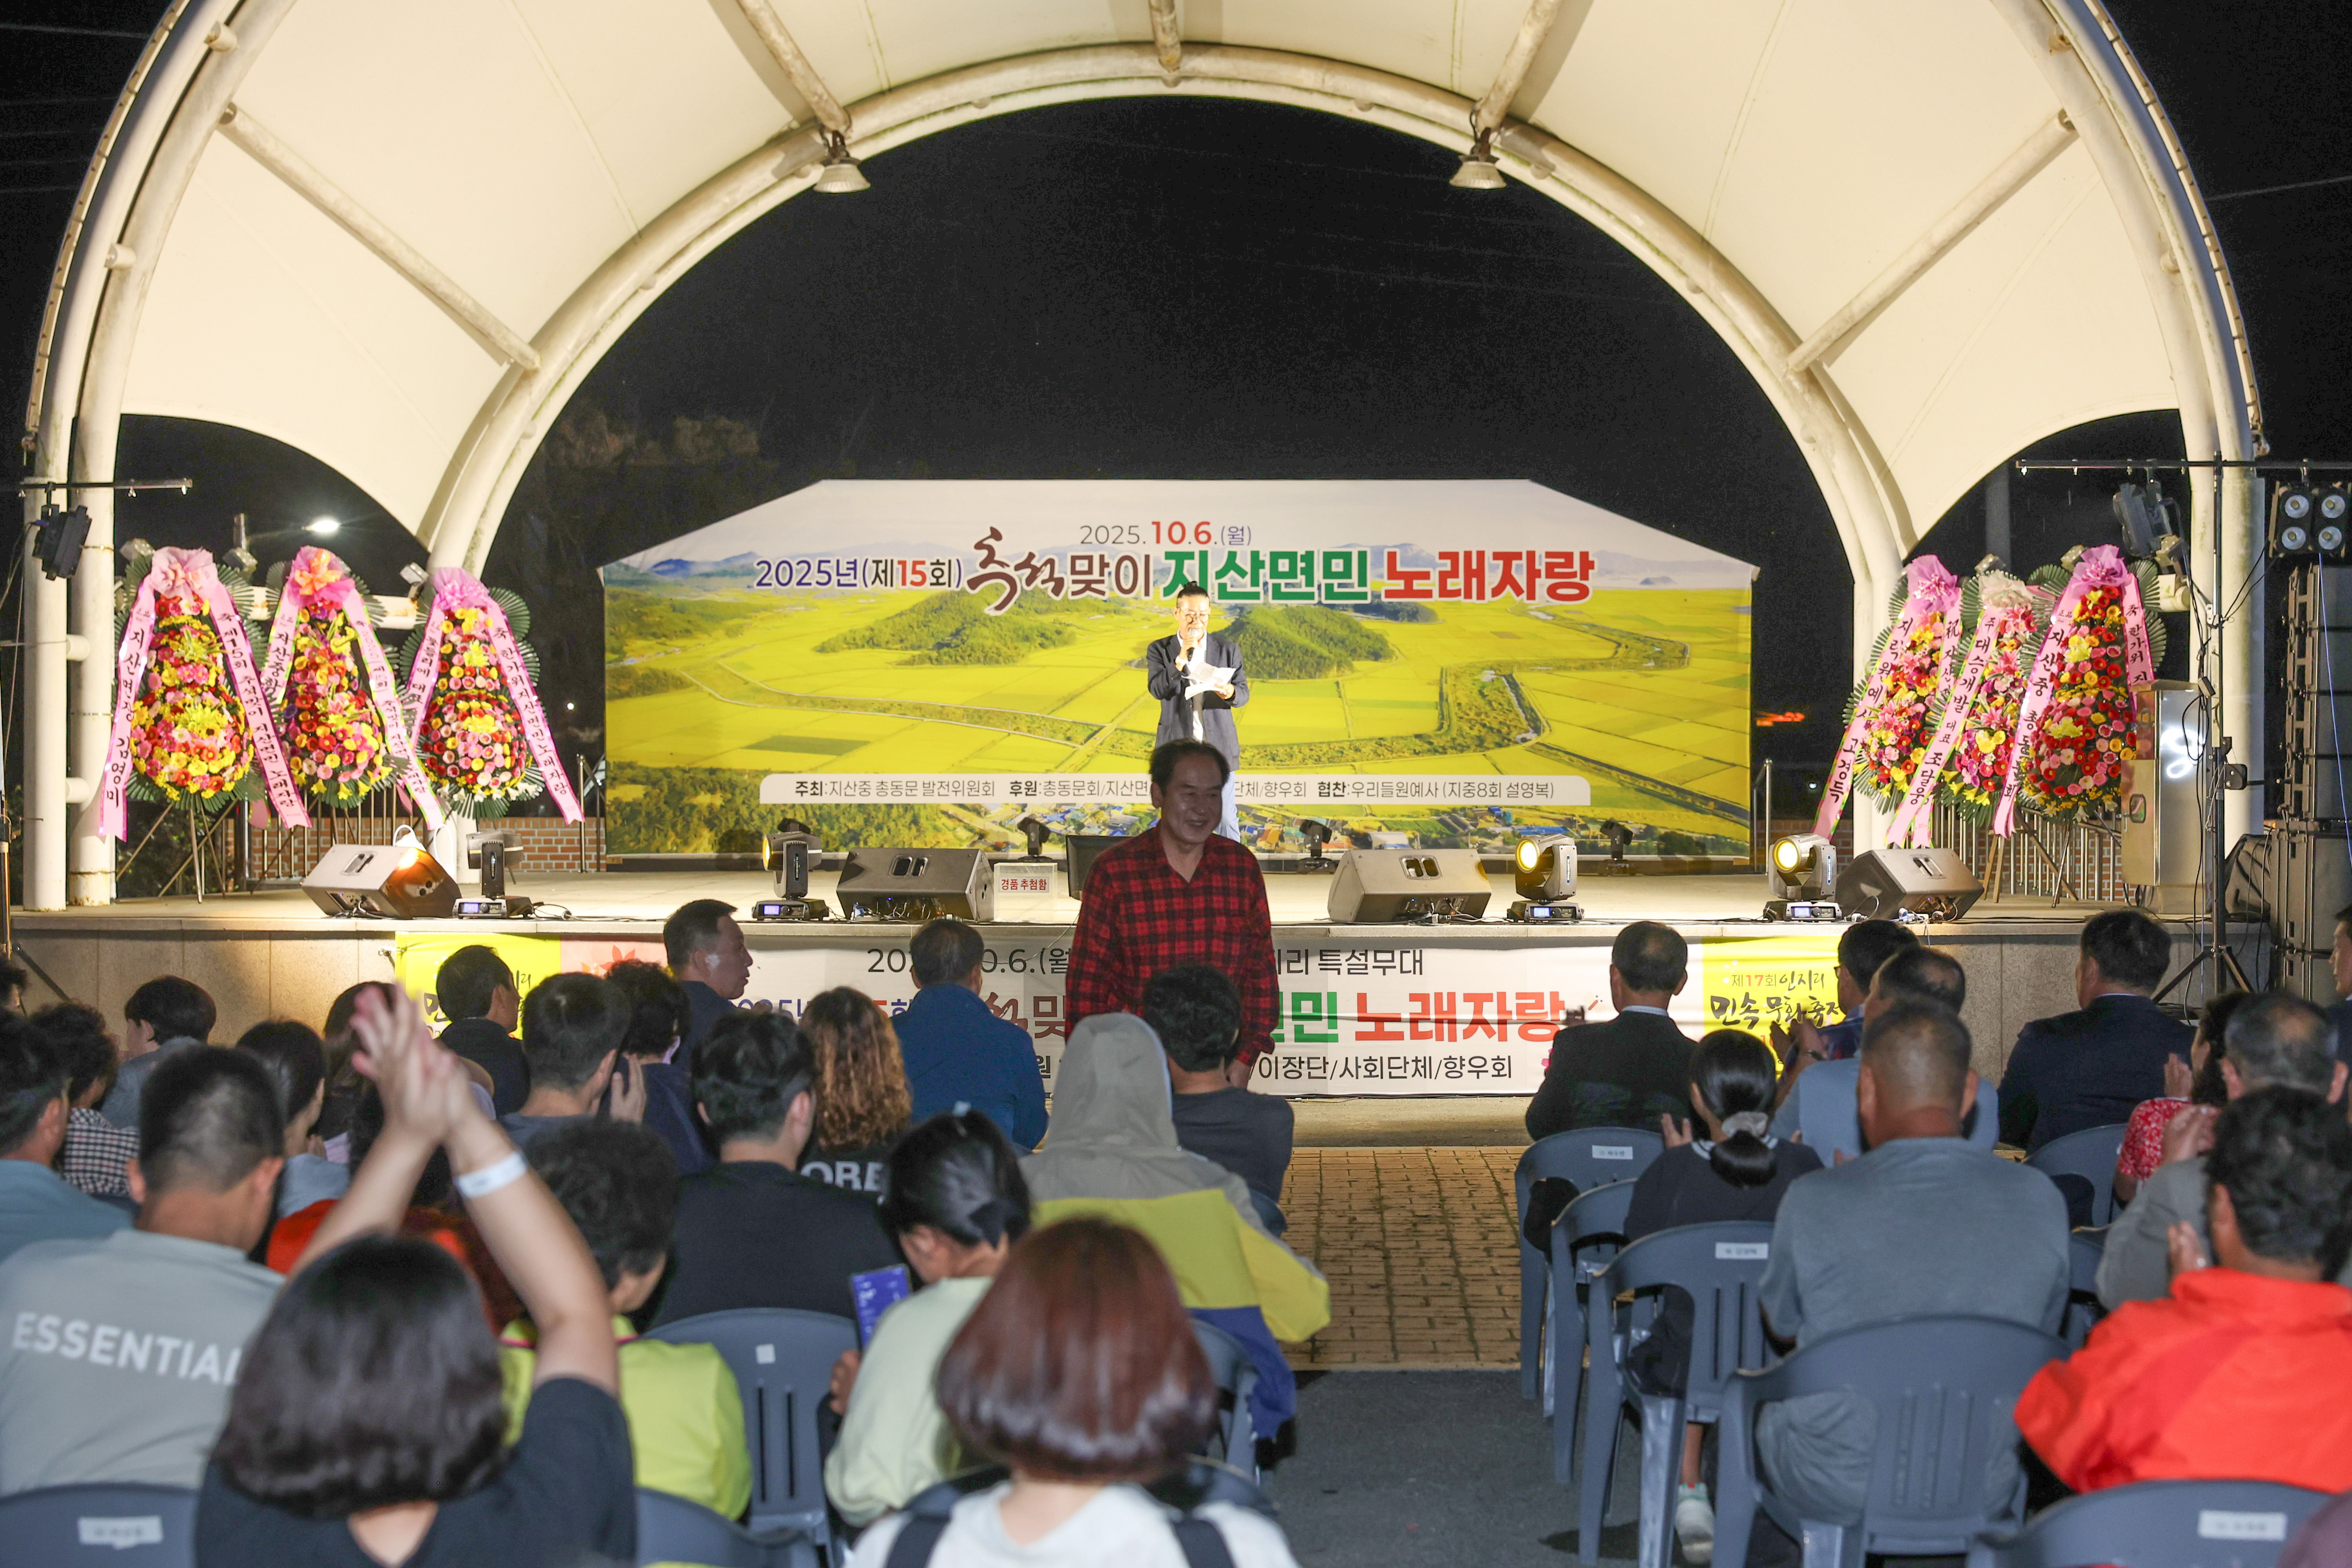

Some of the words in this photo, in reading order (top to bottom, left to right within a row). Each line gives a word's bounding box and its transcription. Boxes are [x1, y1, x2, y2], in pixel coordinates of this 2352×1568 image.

[1080, 521, 1252, 546] 2025.10.6.(월)
[756, 558, 962, 588] 2025년(제15회)
[1162, 550, 1369, 600] 지산면민
[1384, 550, 1595, 601] 노래자랑
[223, 628, 247, 669] 제15회
[121, 628, 145, 722] 지산면장
[1939, 720, 1956, 744] 대표
[106, 736, 130, 808] 김영미
[876, 780, 918, 797] 총동문
[923, 780, 995, 797] 발전위원회
[1009, 780, 1151, 798] 후원:총동문회/지산면
[1235, 781, 1306, 799] 단체/향우회
[1829, 738, 1858, 804] 고경득
[1909, 752, 1943, 805] 조달웅
[1001, 878, 1018, 891] 경품
[1020, 878, 1047, 891] 추첨함
[1318, 949, 1423, 976] 특설무대
[1731, 974, 1776, 987] 제17회
[1779, 970, 1825, 991] 인지리
[1355, 991, 1565, 1042] 노래자랑
[1710, 991, 1759, 1030] 민속
